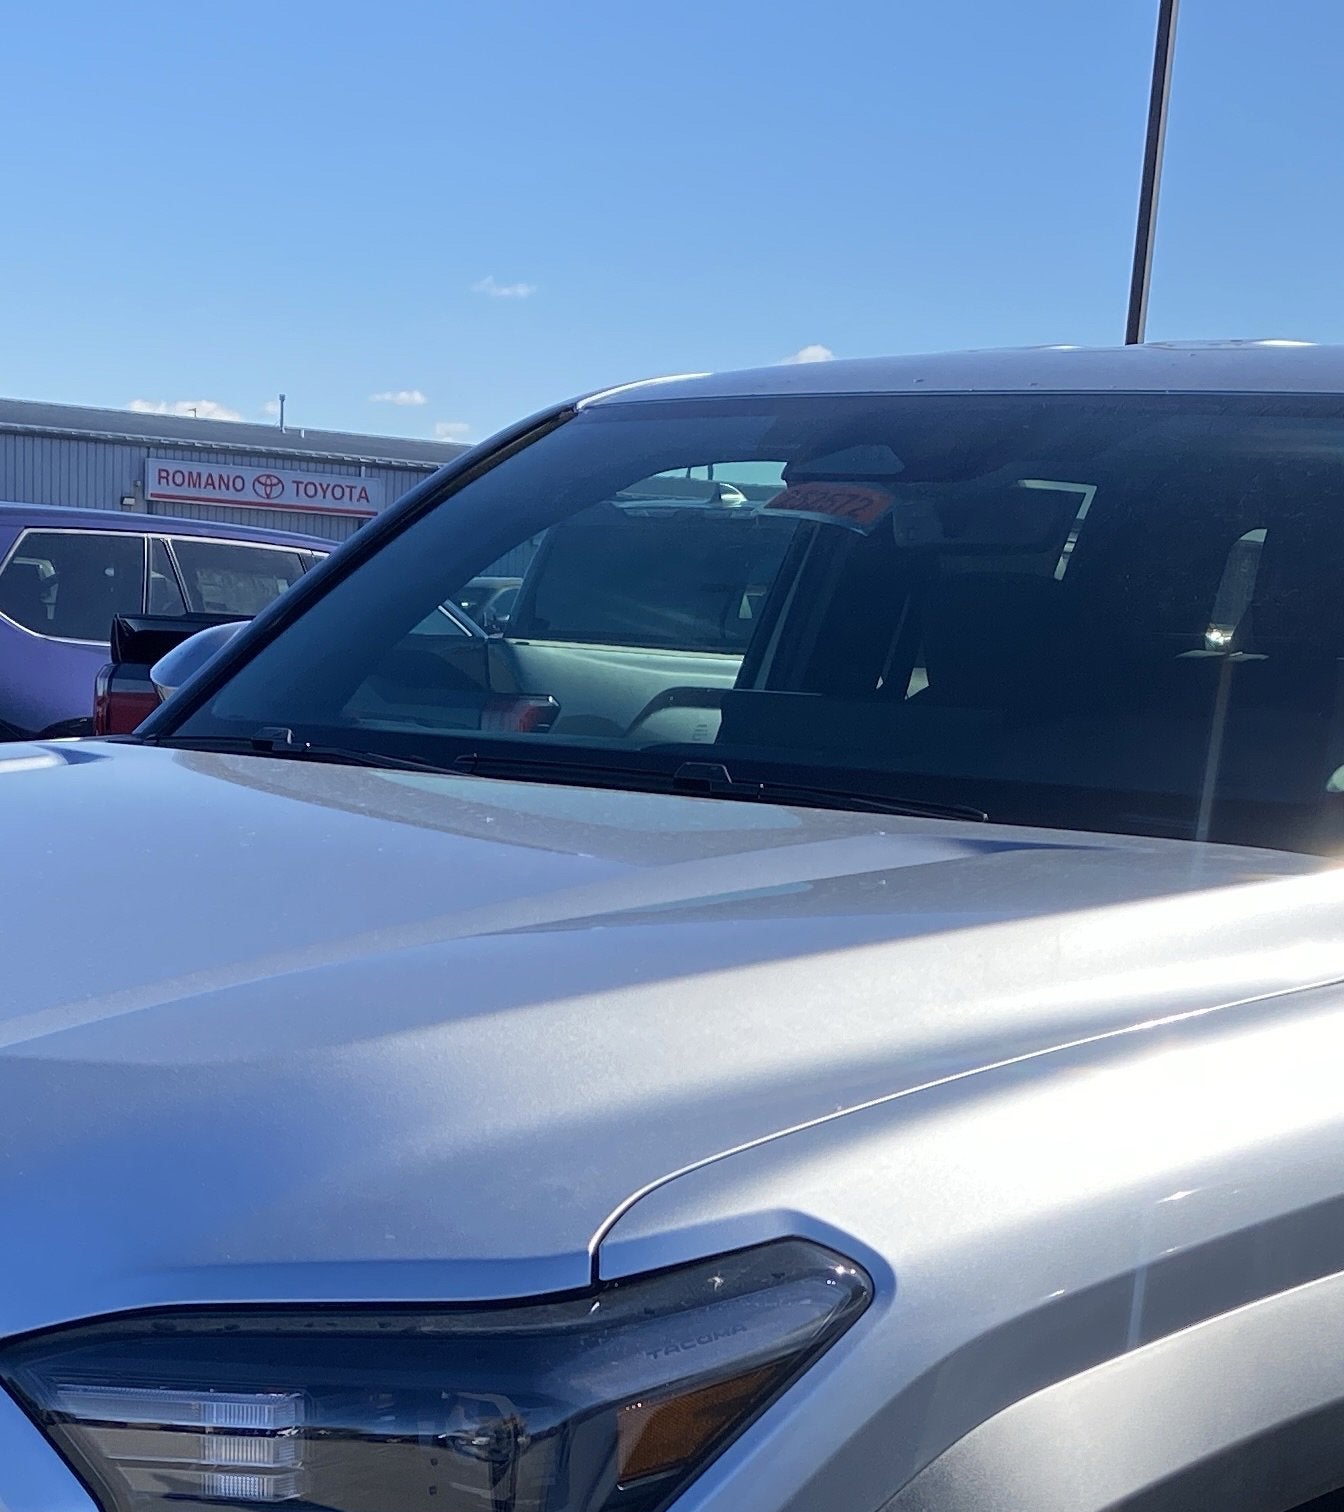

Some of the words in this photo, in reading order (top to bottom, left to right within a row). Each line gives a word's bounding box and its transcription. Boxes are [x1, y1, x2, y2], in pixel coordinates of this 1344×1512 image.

[157, 468, 246, 493] ROMANO
[292, 480, 370, 504] TOYOTA
[642, 1325, 748, 1360] TACOMA
